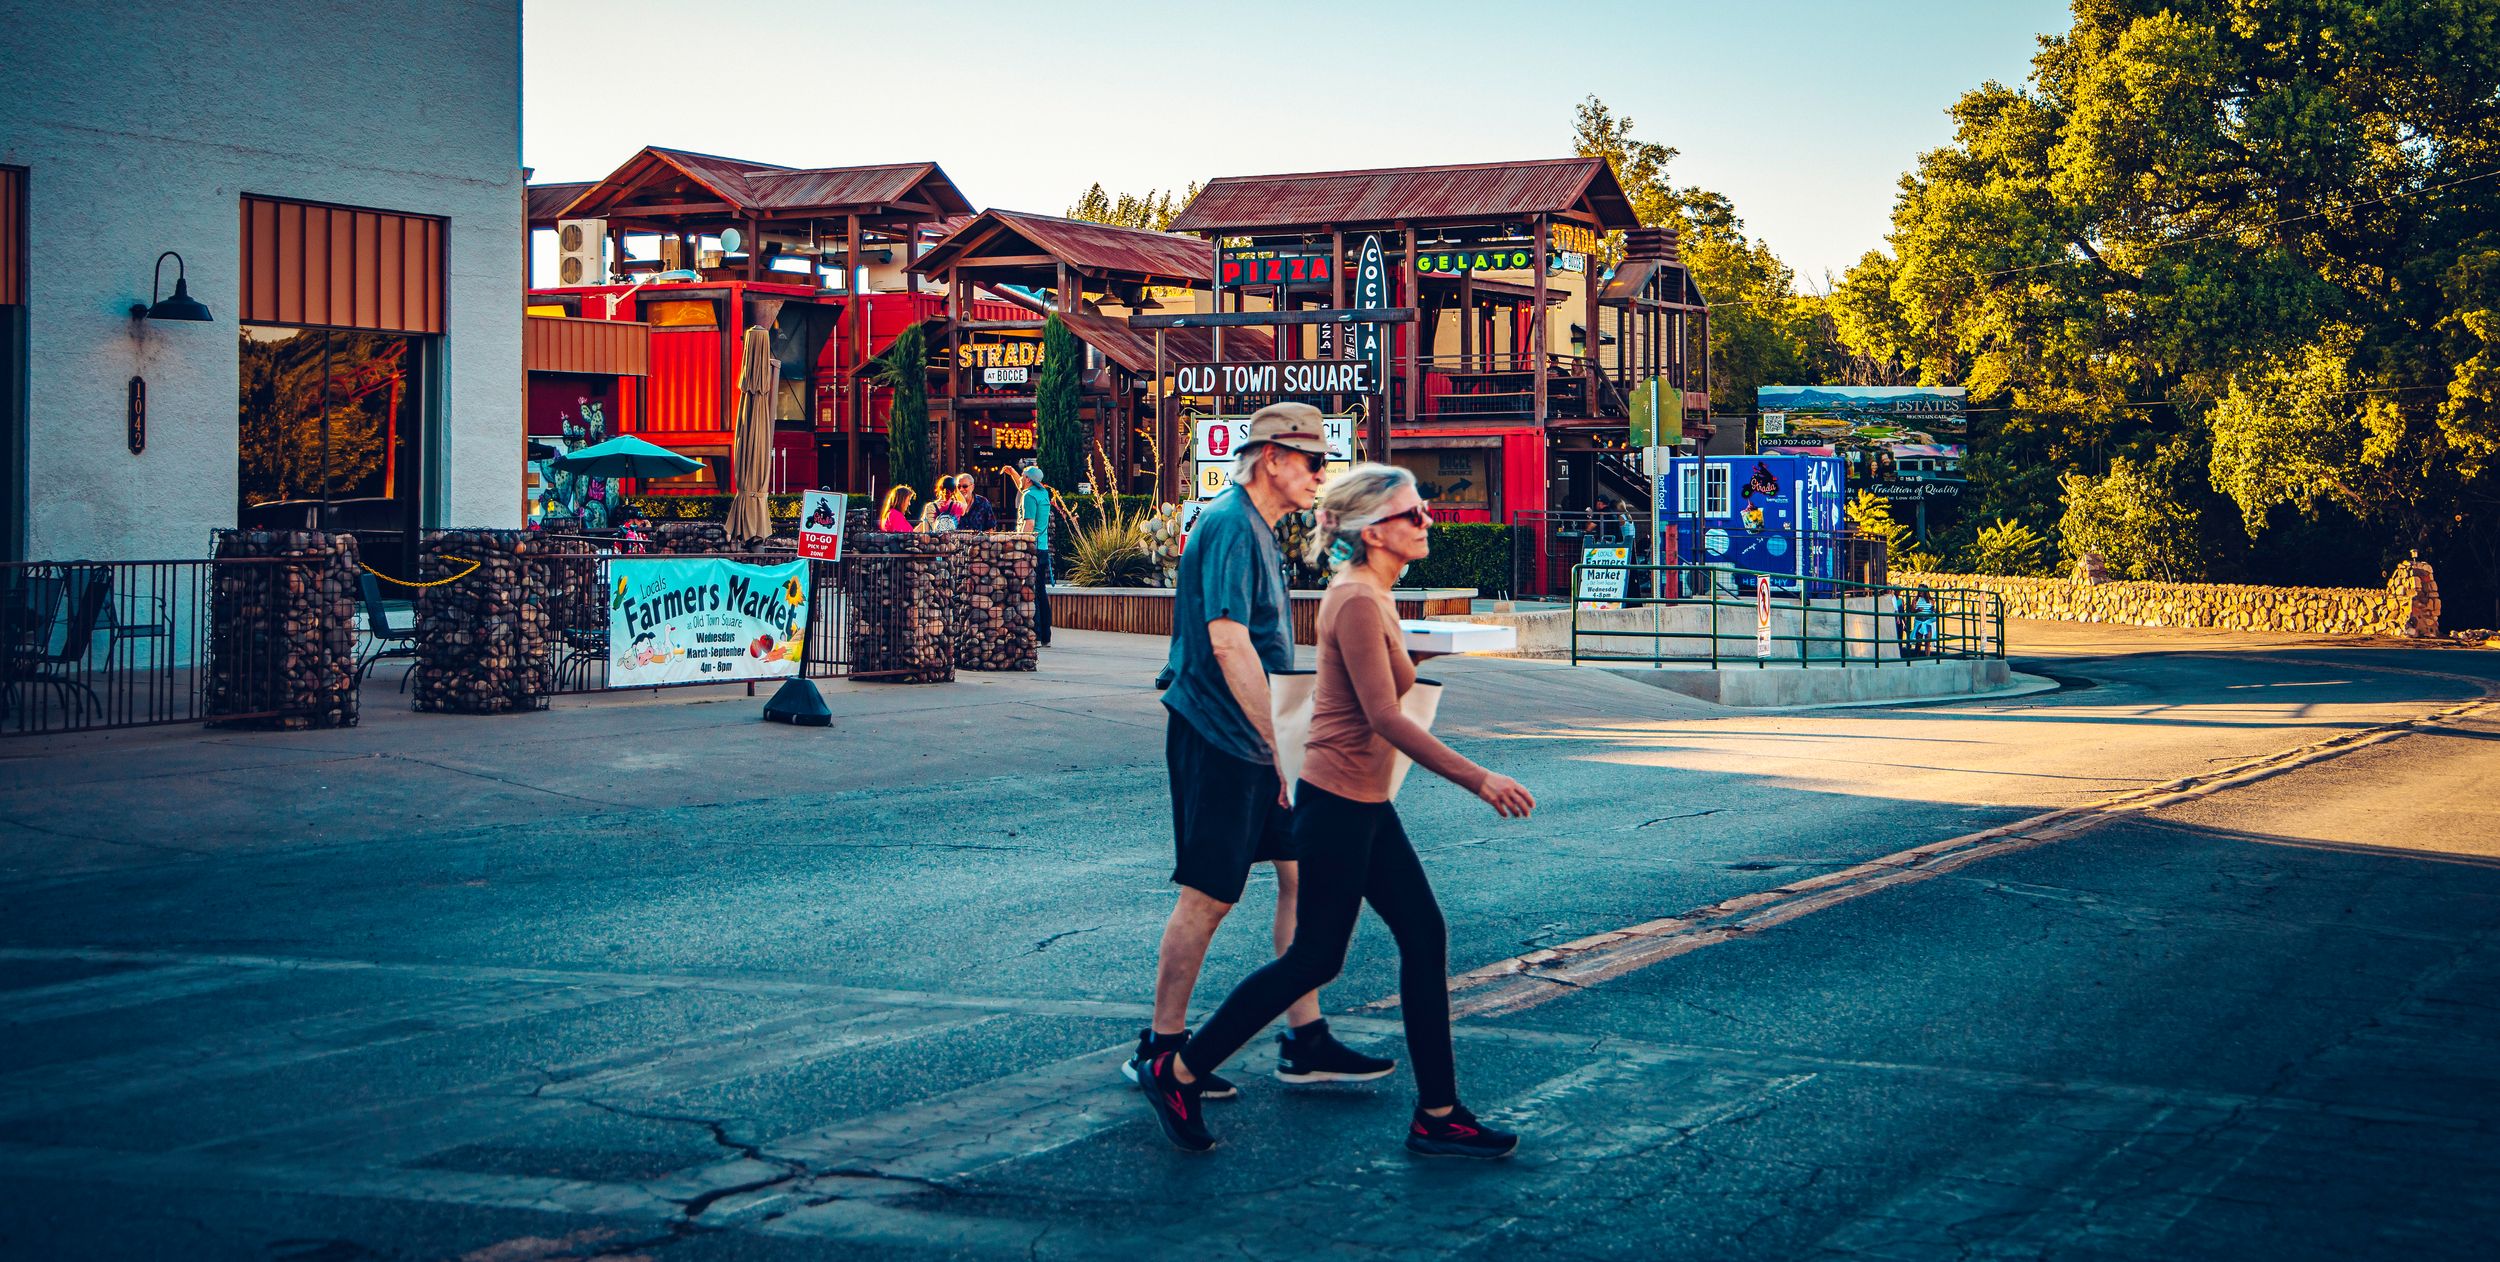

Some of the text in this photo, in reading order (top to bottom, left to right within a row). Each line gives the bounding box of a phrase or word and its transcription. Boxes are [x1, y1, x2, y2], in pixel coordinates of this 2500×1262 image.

[1552, 223, 1596, 255] STRADA
[1223, 258, 1329, 283] PIZZA
[1417, 252, 1528, 270] GELATO
[1365, 248, 1378, 384] COCKTAI
[958, 341, 1045, 368] STRADA
[987, 369, 1024, 381] AT BOCCE
[1178, 364, 1369, 393] OLD TOWN SQUARE
[134, 383, 142, 448] 1042
[1895, 399, 1960, 412] ESTATES
[995, 428, 1033, 449] FOOD
[1759, 438, 1782, 446] (928)
[1659, 474, 1668, 510] perfood
[1872, 483, 1959, 498] Tradition of Quality
[805, 533, 833, 544] TO-GO
[1585, 557, 1625, 566] Farmers
[1587, 568, 1620, 581] Market
[640, 575, 667, 600] Locals
[623, 574, 797, 639] Farmers Market
[693, 615, 705, 628] Old
[706, 614, 720, 626] Town
[722, 613, 743, 629] Square
